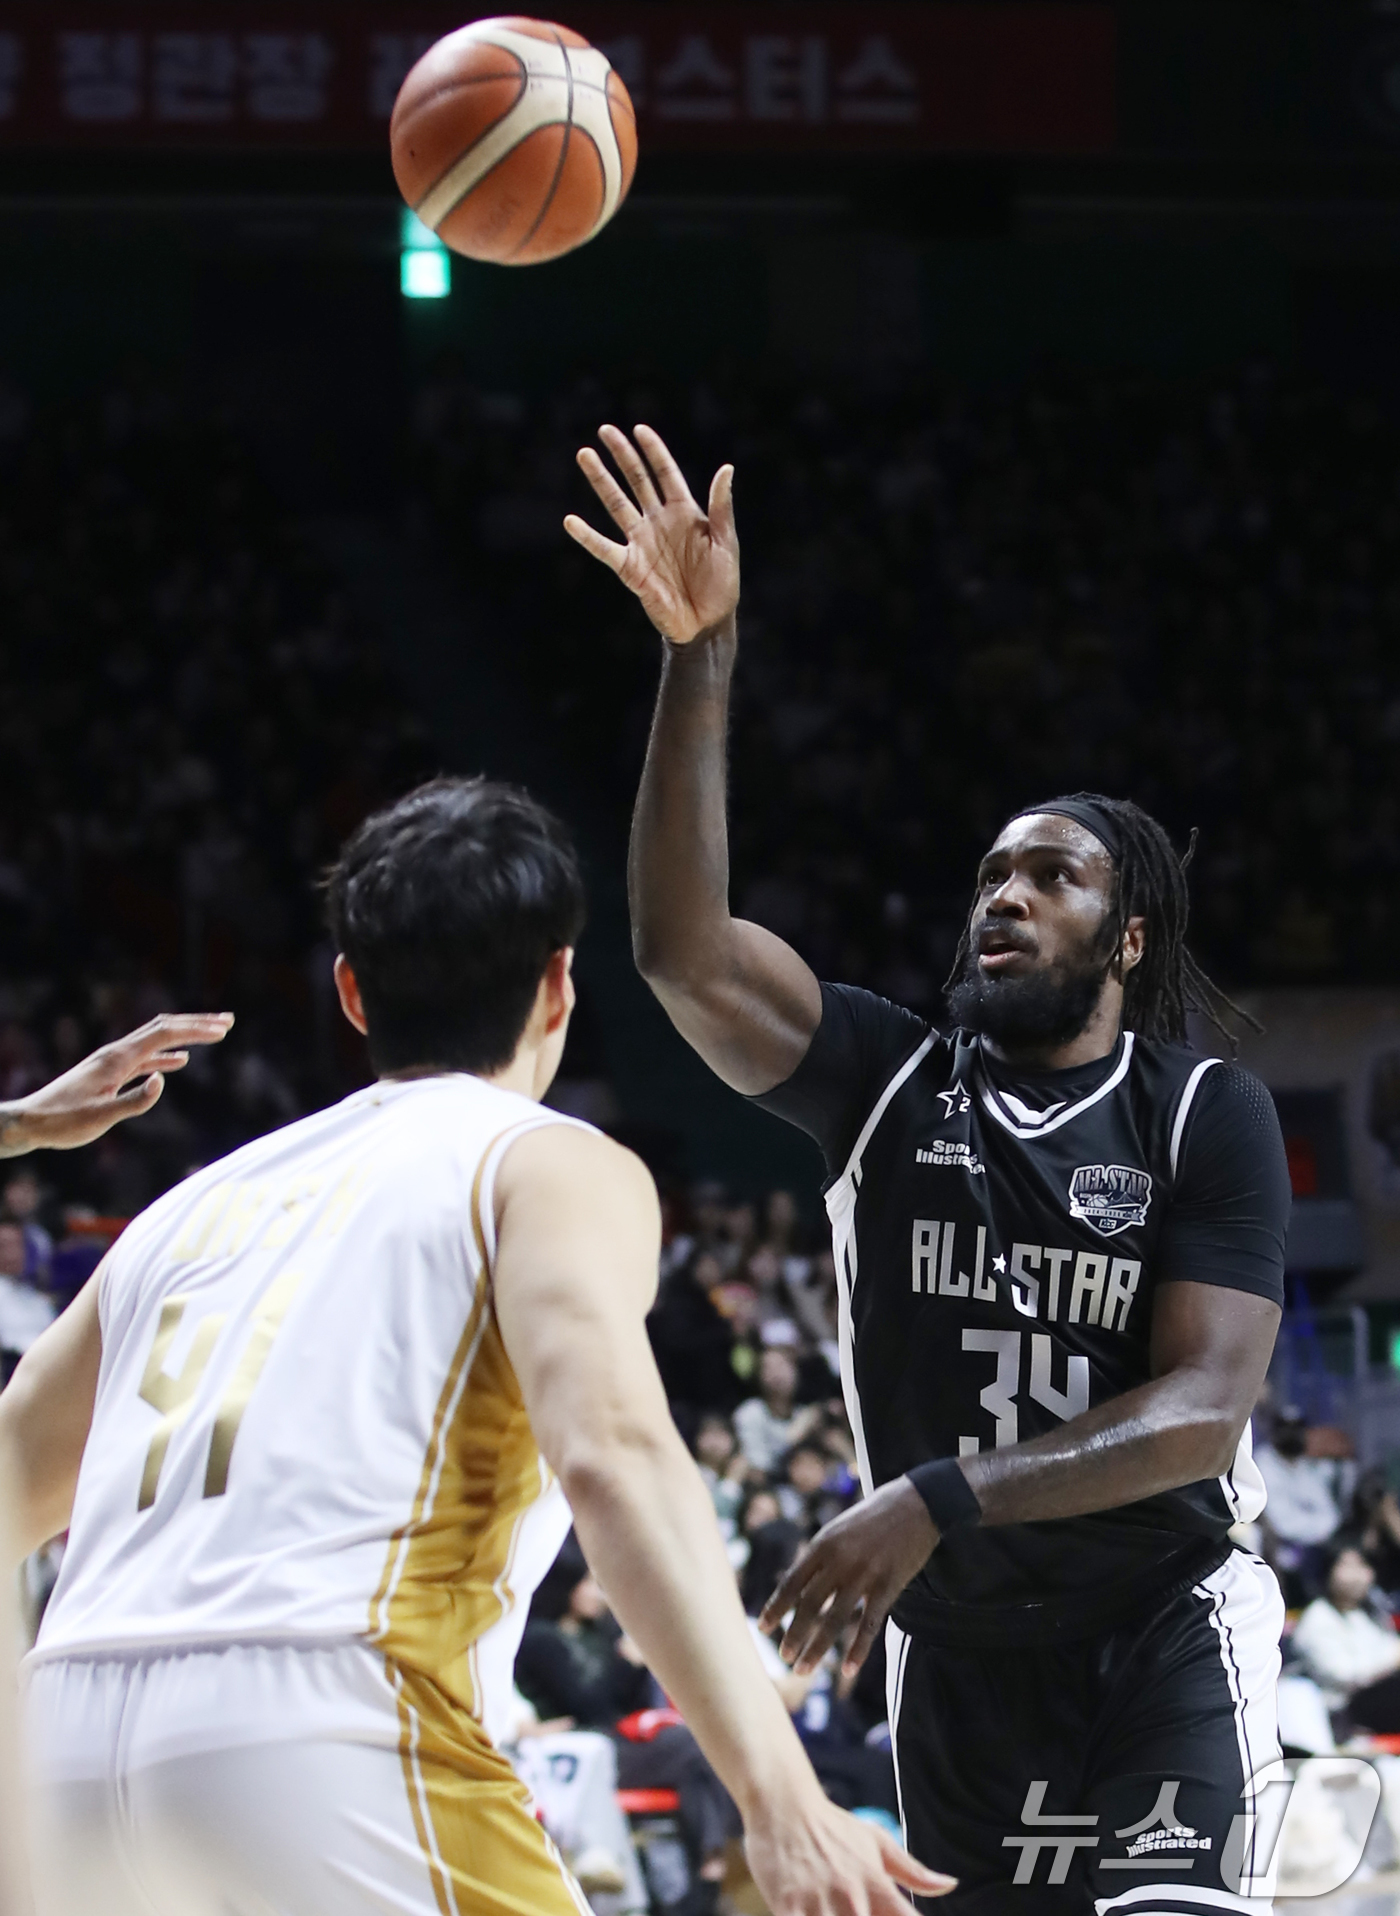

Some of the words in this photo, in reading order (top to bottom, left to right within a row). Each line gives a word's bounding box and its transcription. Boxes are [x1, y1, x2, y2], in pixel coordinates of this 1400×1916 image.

[58, 32, 332, 121] 정관장
[137, 1271, 306, 1512] 41
[958, 1328, 1090, 1458] 34
